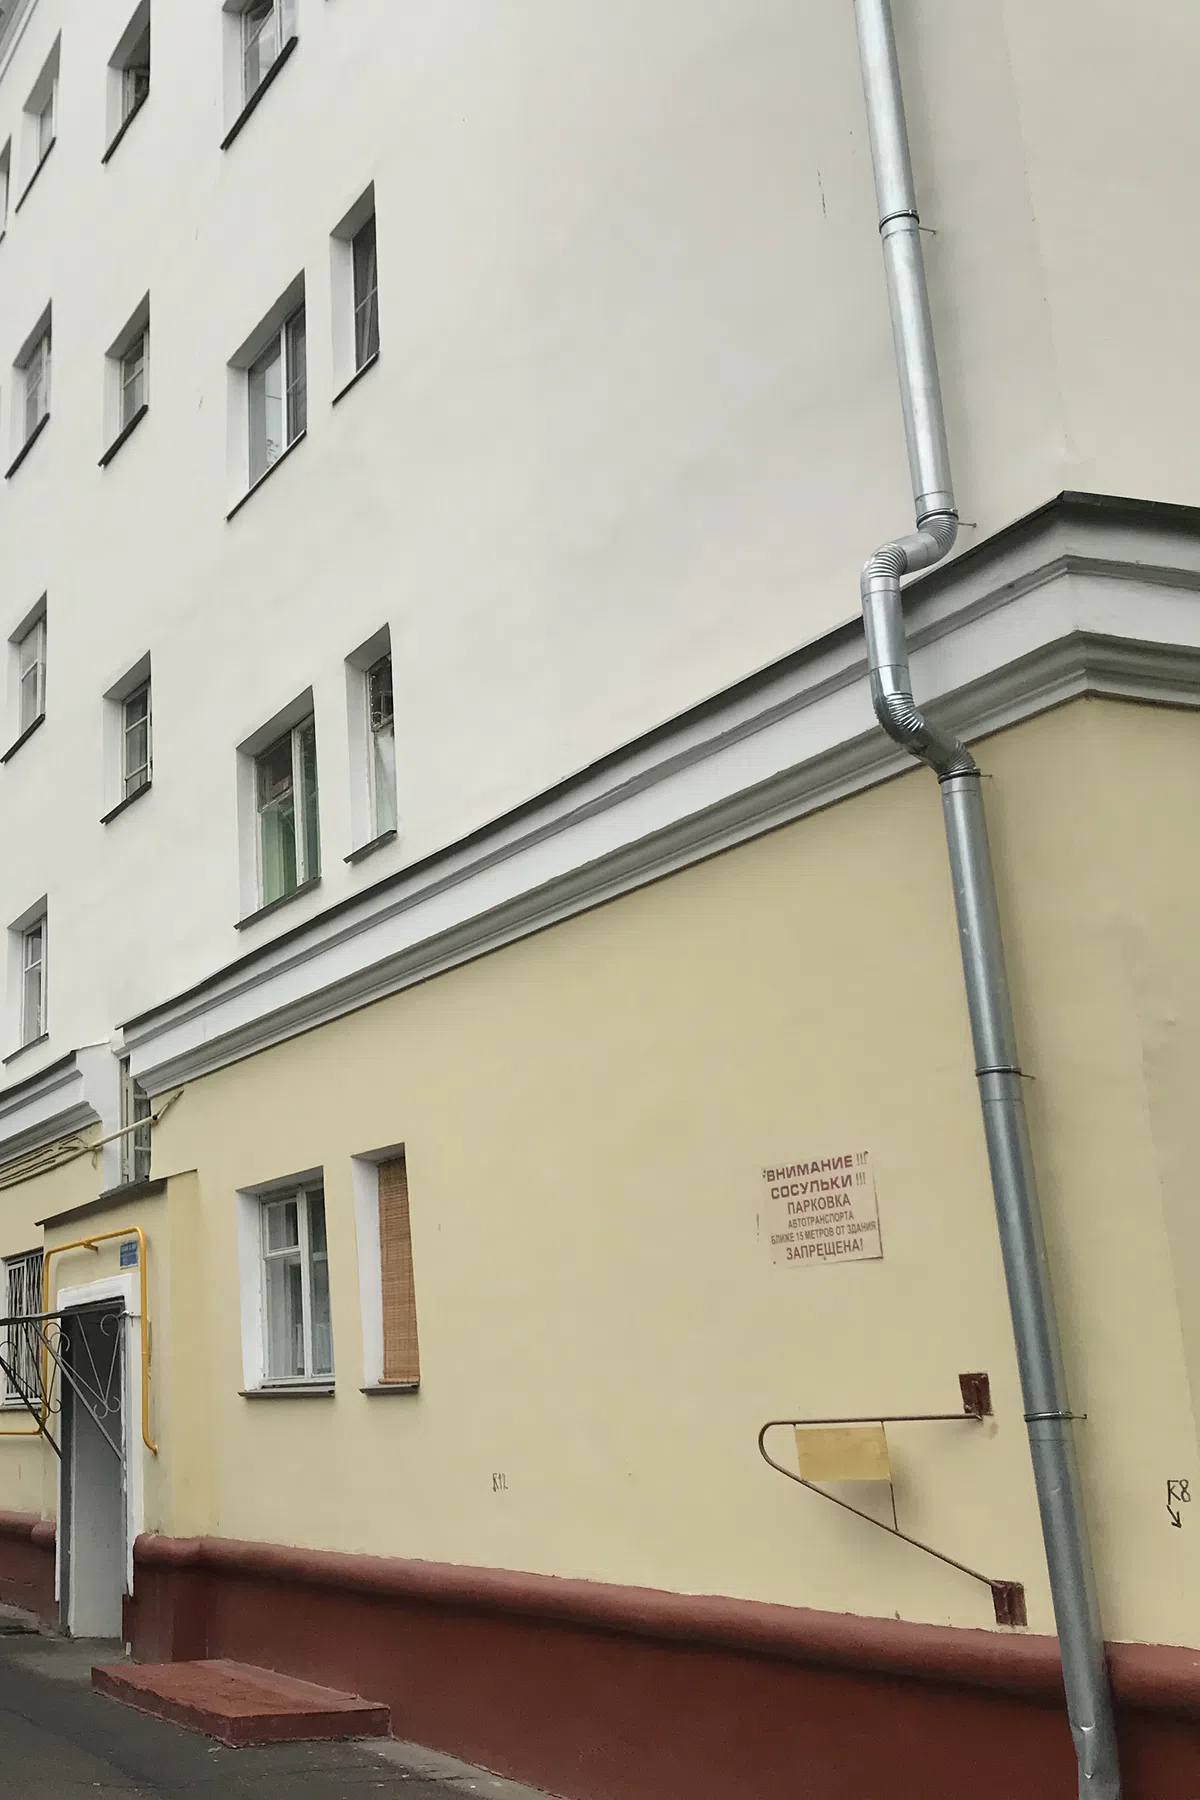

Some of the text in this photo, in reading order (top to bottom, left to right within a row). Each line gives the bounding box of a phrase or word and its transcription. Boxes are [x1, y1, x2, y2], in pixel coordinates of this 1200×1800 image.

[766, 1155, 853, 1182] ВНИМАНИЕ
[770, 1174, 853, 1200] СОСУЛЬКИ
[787, 1193, 851, 1215] ПАРКОВКА
[788, 1210, 854, 1229] АВТОТРАНСПОРТА
[770, 1220, 877, 1245] БЛИЖЕ 15 МЕТРОВ ОТ ЗДАНИЯ
[786, 1238, 864, 1261] ЗАПРЕЩЕНА!
